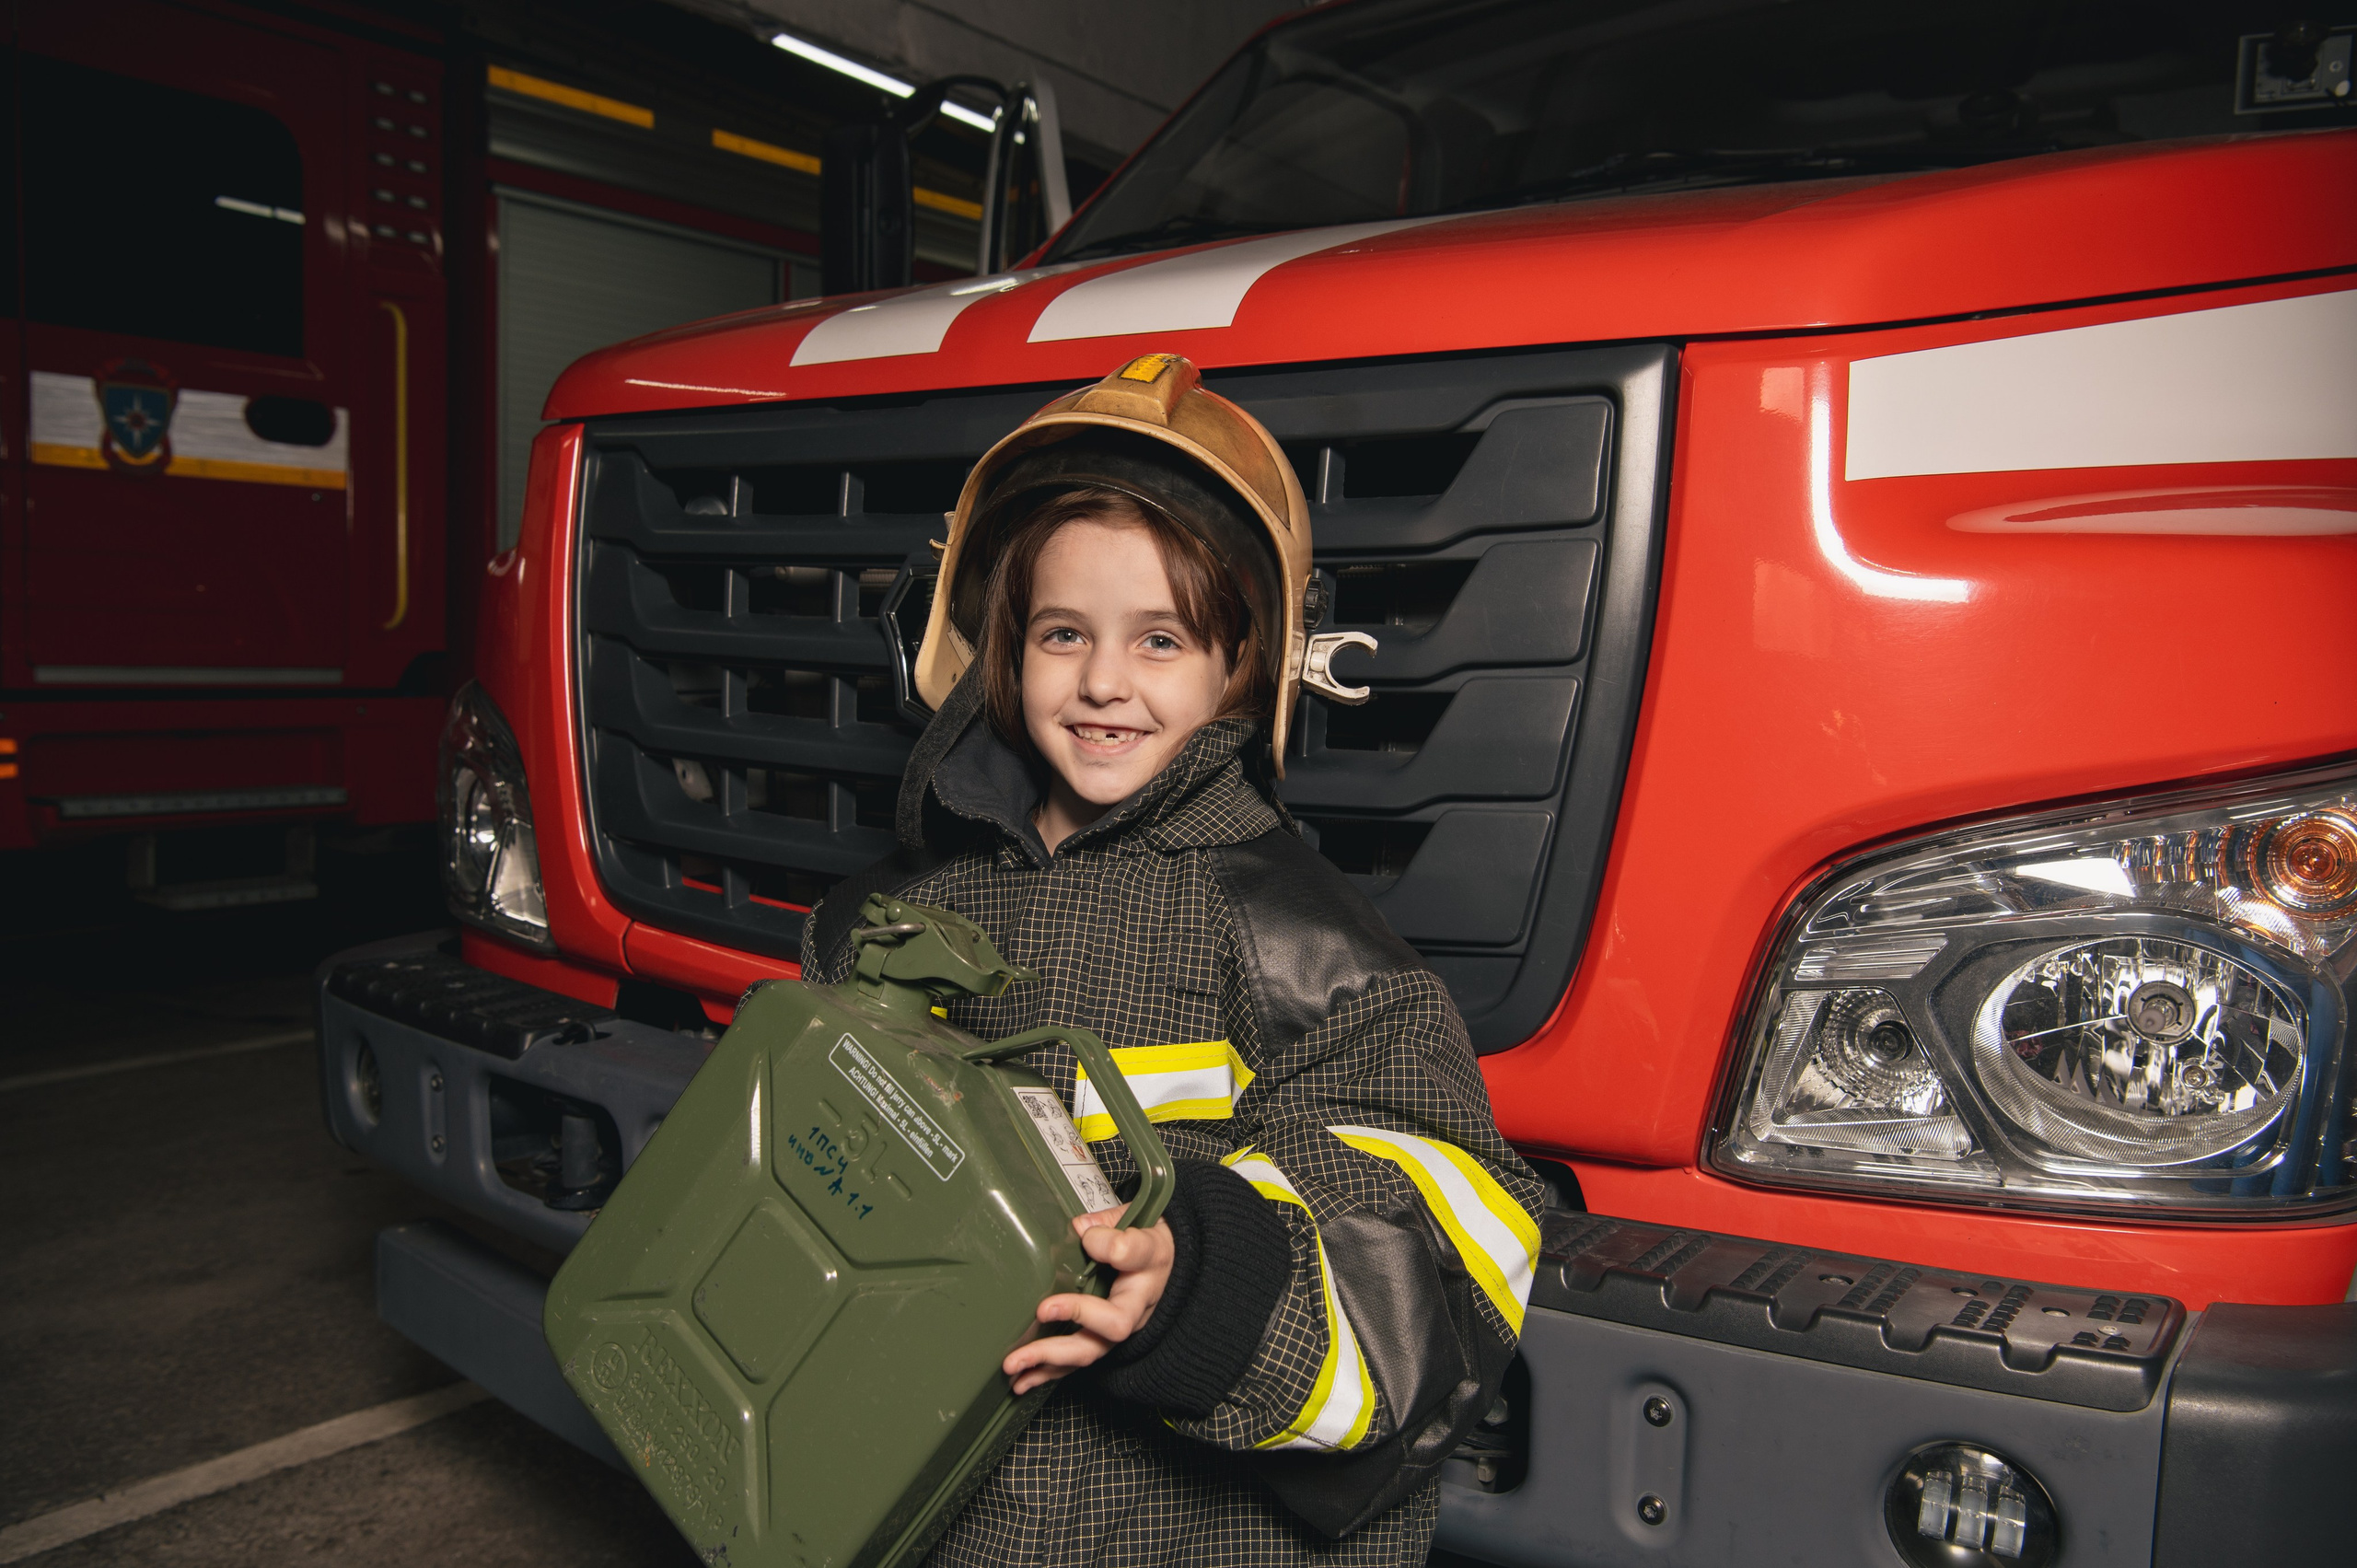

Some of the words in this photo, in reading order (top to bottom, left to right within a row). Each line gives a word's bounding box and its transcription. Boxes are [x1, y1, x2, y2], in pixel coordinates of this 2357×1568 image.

[842, 1039, 871, 1070] WARNING!
[868, 1065, 877, 1078] Do
[876, 1075, 887, 1087] not
[884, 1083, 895, 1095] fill
[889, 1090, 906, 1109] jerry
[848, 1066, 879, 1098] ACHTUNG!
[876, 1094, 900, 1121] Maximal
[900, 1119, 908, 1132] 5L
[910, 1132, 933, 1157] einfüllen
[904, 1105, 915, 1118] can
[913, 1116, 931, 1135] above
[942, 1145, 958, 1163] mark
[632, 1326, 741, 1467] REXXON
